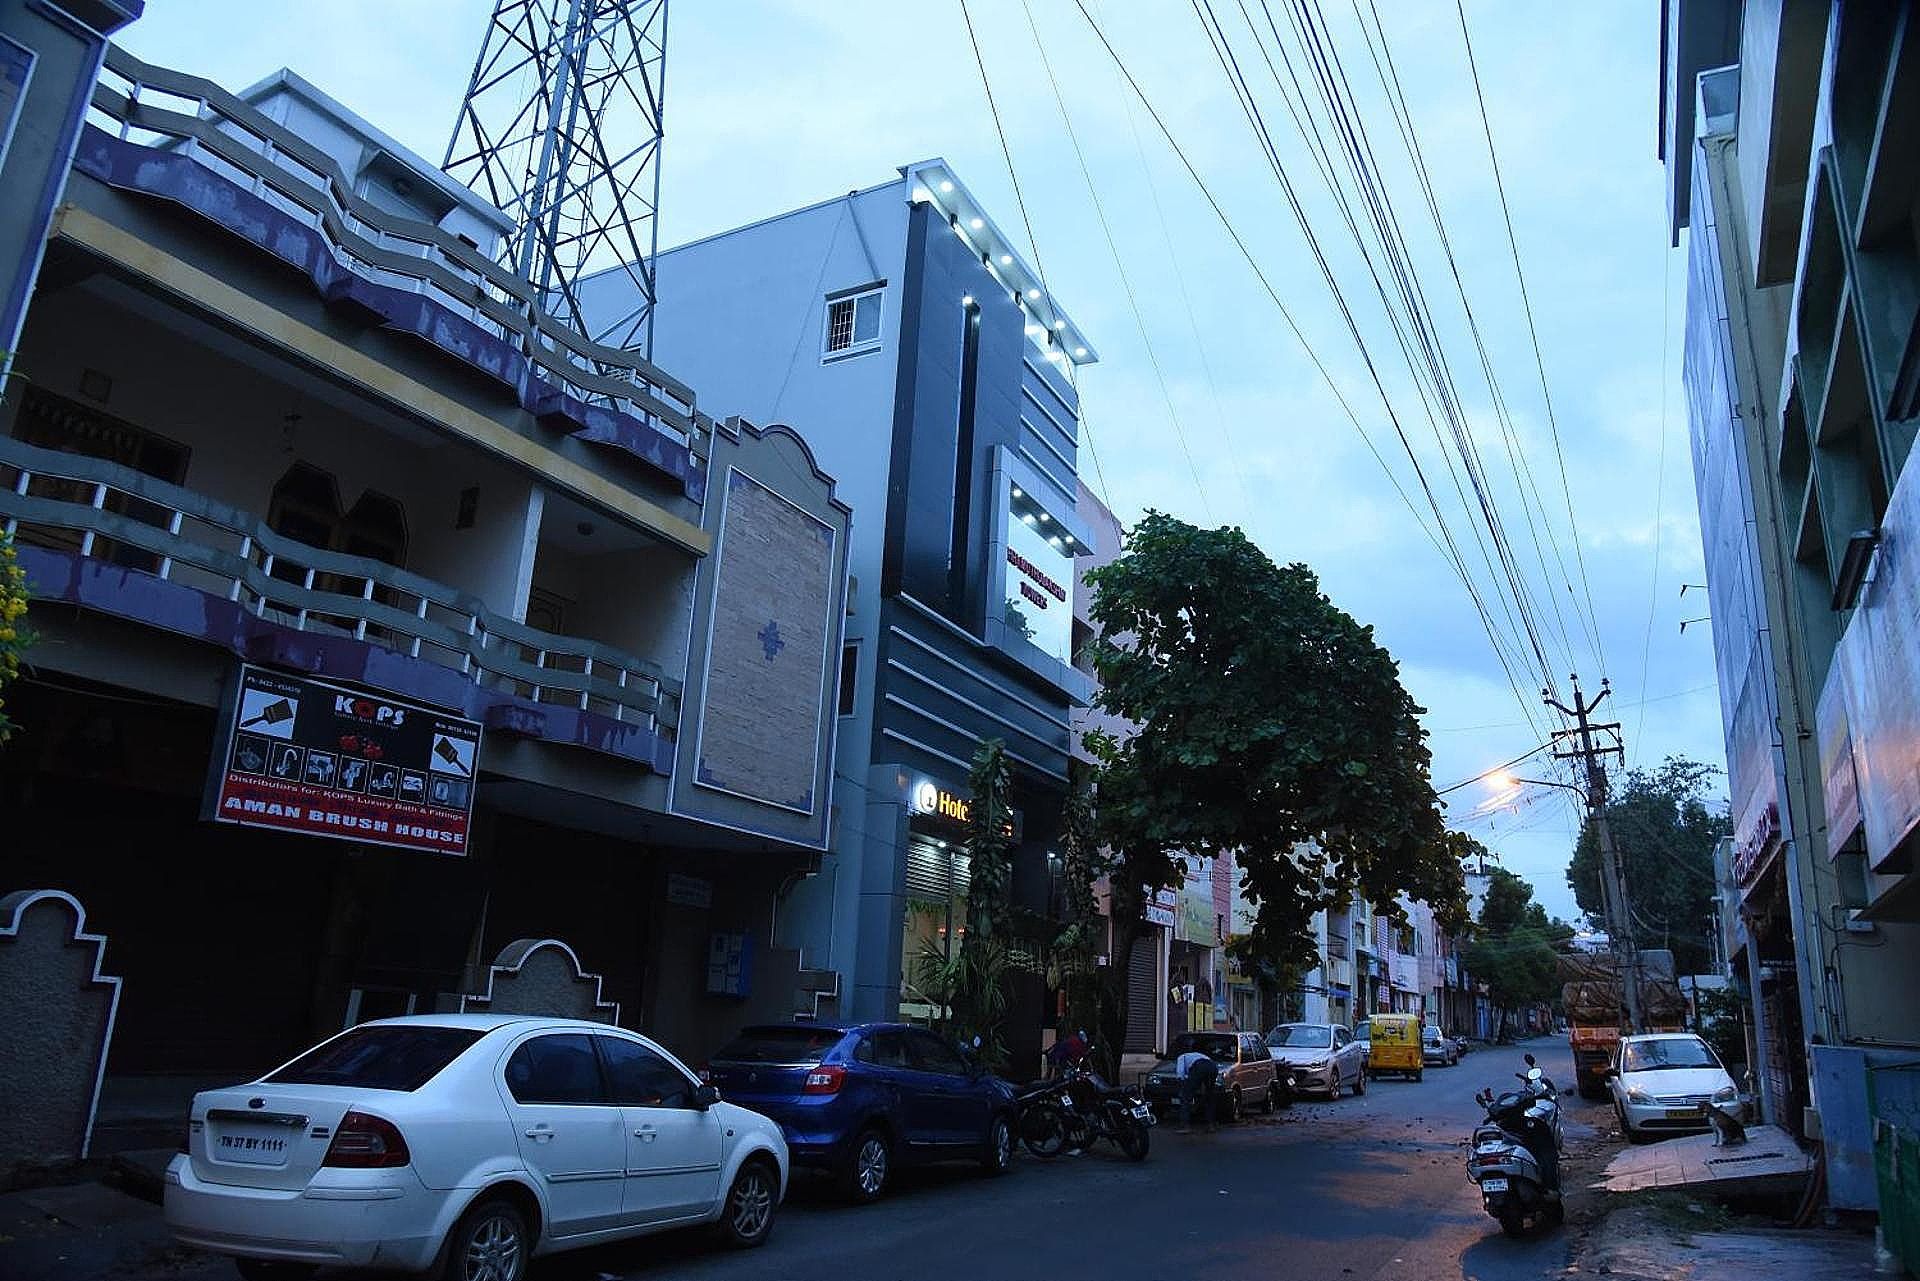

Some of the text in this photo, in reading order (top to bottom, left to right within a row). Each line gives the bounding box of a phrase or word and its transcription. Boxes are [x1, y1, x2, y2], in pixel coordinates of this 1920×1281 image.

[228, 774, 298, 793] Distributors
[938, 790, 972, 823] Hote
[225, 797, 465, 844] AMAN BRUSH HOUSE
[221, 1136, 233, 1147] TN
[246, 1137, 258, 1149] BY
[261, 1137, 284, 1152] 1111
